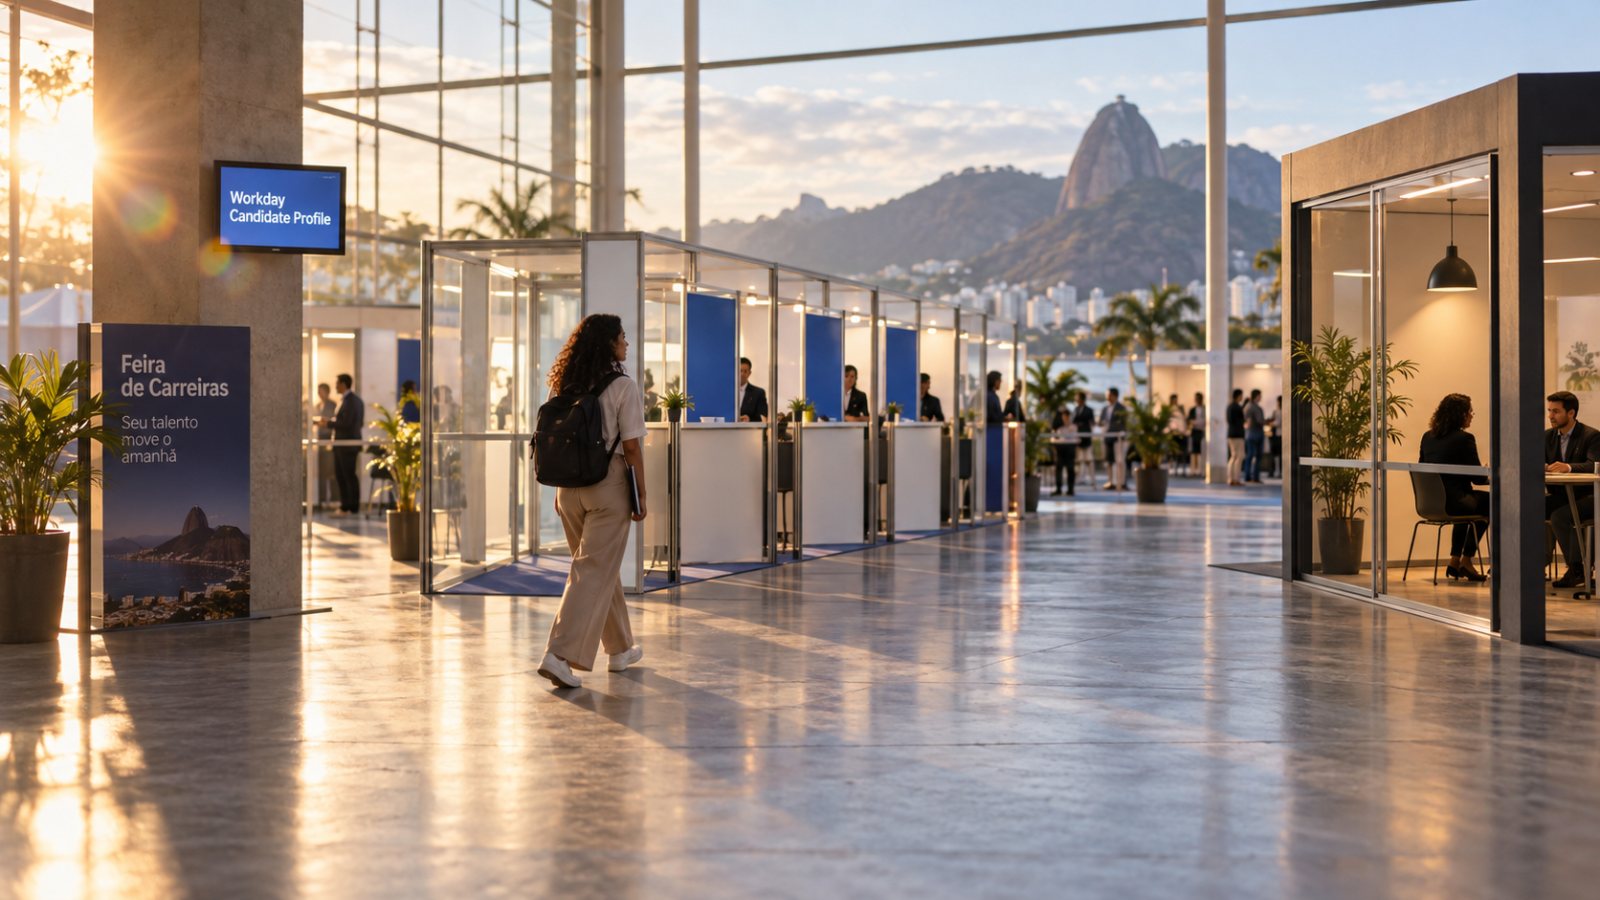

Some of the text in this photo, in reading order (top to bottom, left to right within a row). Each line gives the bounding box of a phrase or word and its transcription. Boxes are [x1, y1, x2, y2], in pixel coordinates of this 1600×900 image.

[230, 190, 285, 208] Workday
[229, 209, 331, 225] Candidate Profile
[121, 354, 165, 374] Feira
[121, 377, 229, 397] de Carreiras
[121, 415, 199, 430] Seu talento
[121, 435, 172, 446] move o
